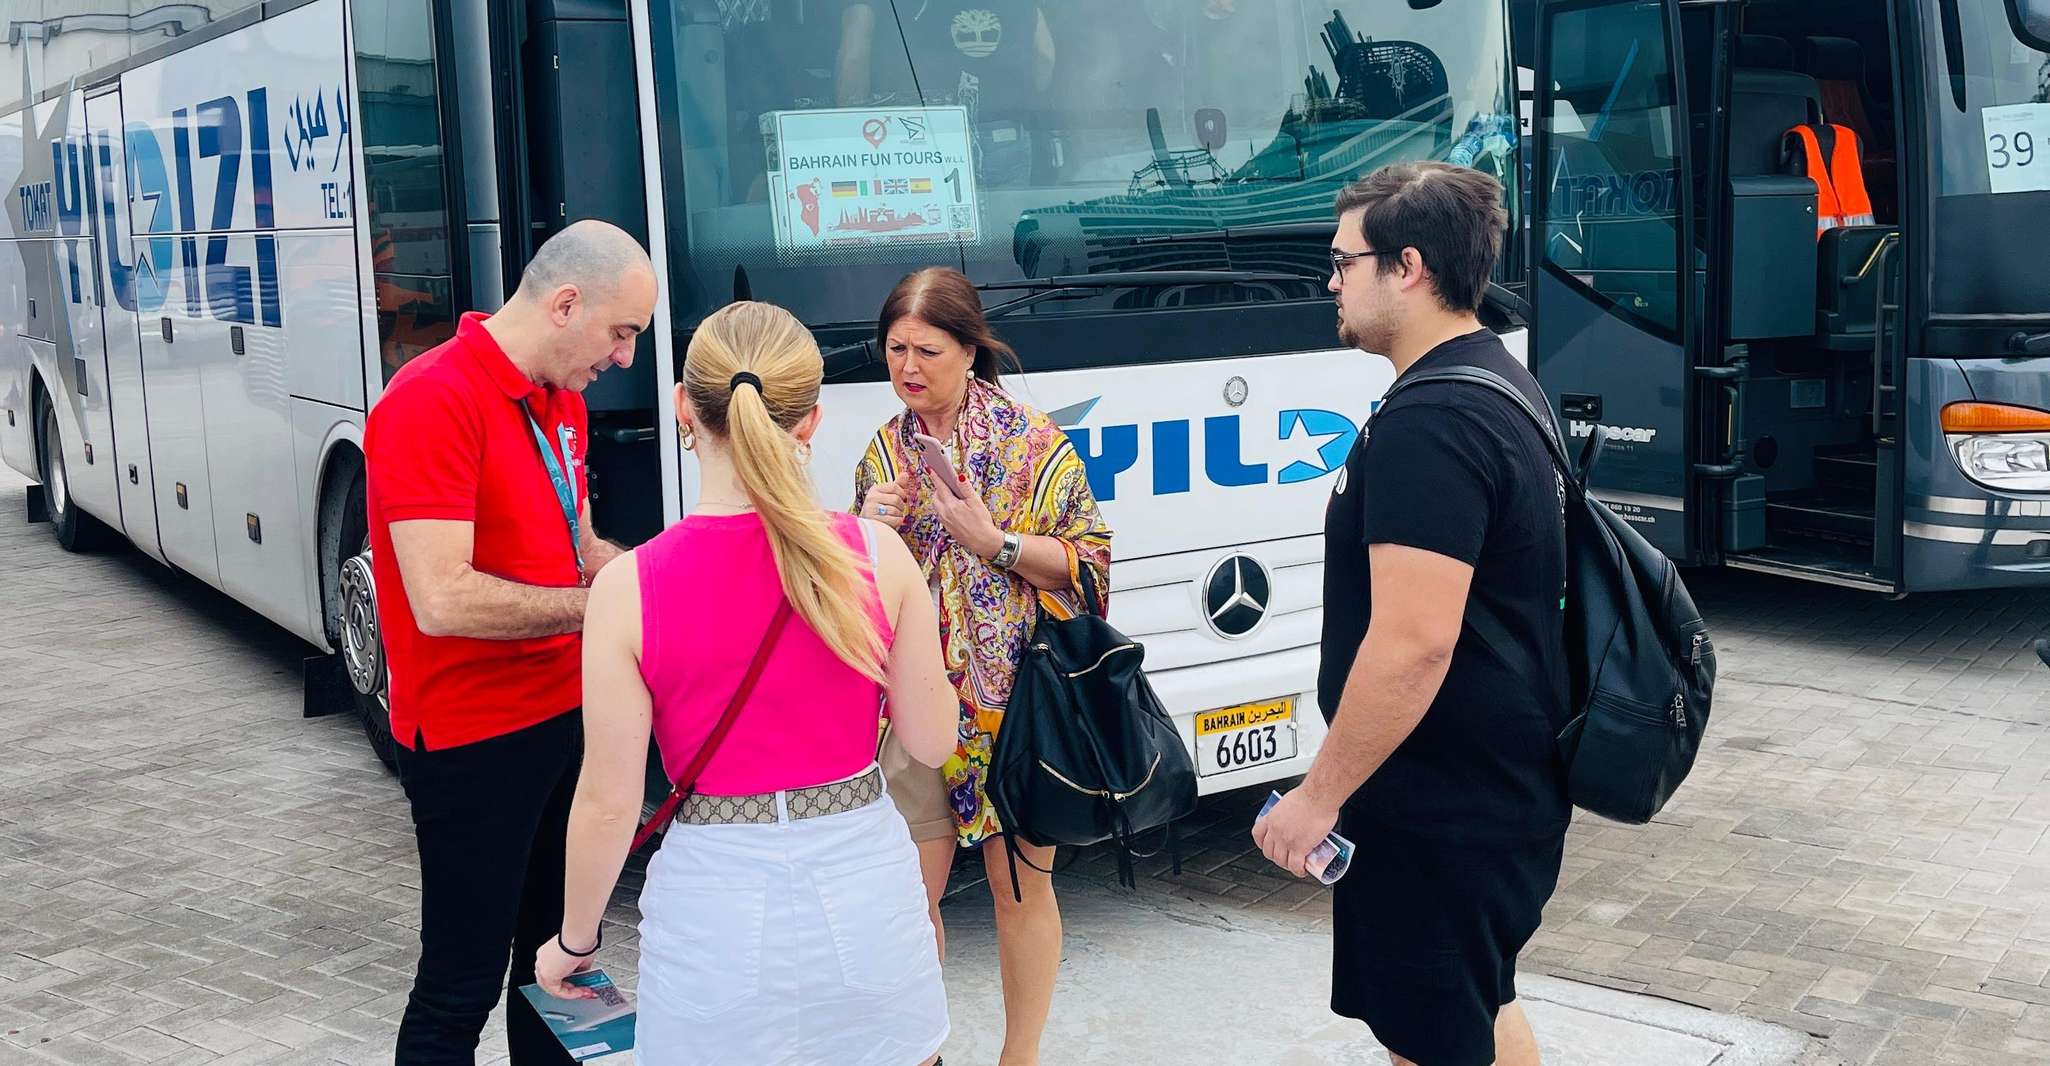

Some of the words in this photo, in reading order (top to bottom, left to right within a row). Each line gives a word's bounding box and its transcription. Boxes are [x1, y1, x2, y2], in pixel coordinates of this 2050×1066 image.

[789, 154, 857, 170] BAHRAIN
[861, 153, 891, 167] FUN
[894, 151, 943, 165] TOURS
[1989, 131, 2034, 169] 39
[943, 167, 962, 203] 1
[20, 182, 53, 232] TOKAT
[51, 86, 282, 328] YILDIZI
[1569, 420, 1657, 443] Hscar
[1068, 401, 1381, 502] YILD
[1203, 711, 1245, 732] BAHRAIN
[1247, 701, 1287, 724] البحرين
[1216, 725, 1277, 768] 6603
